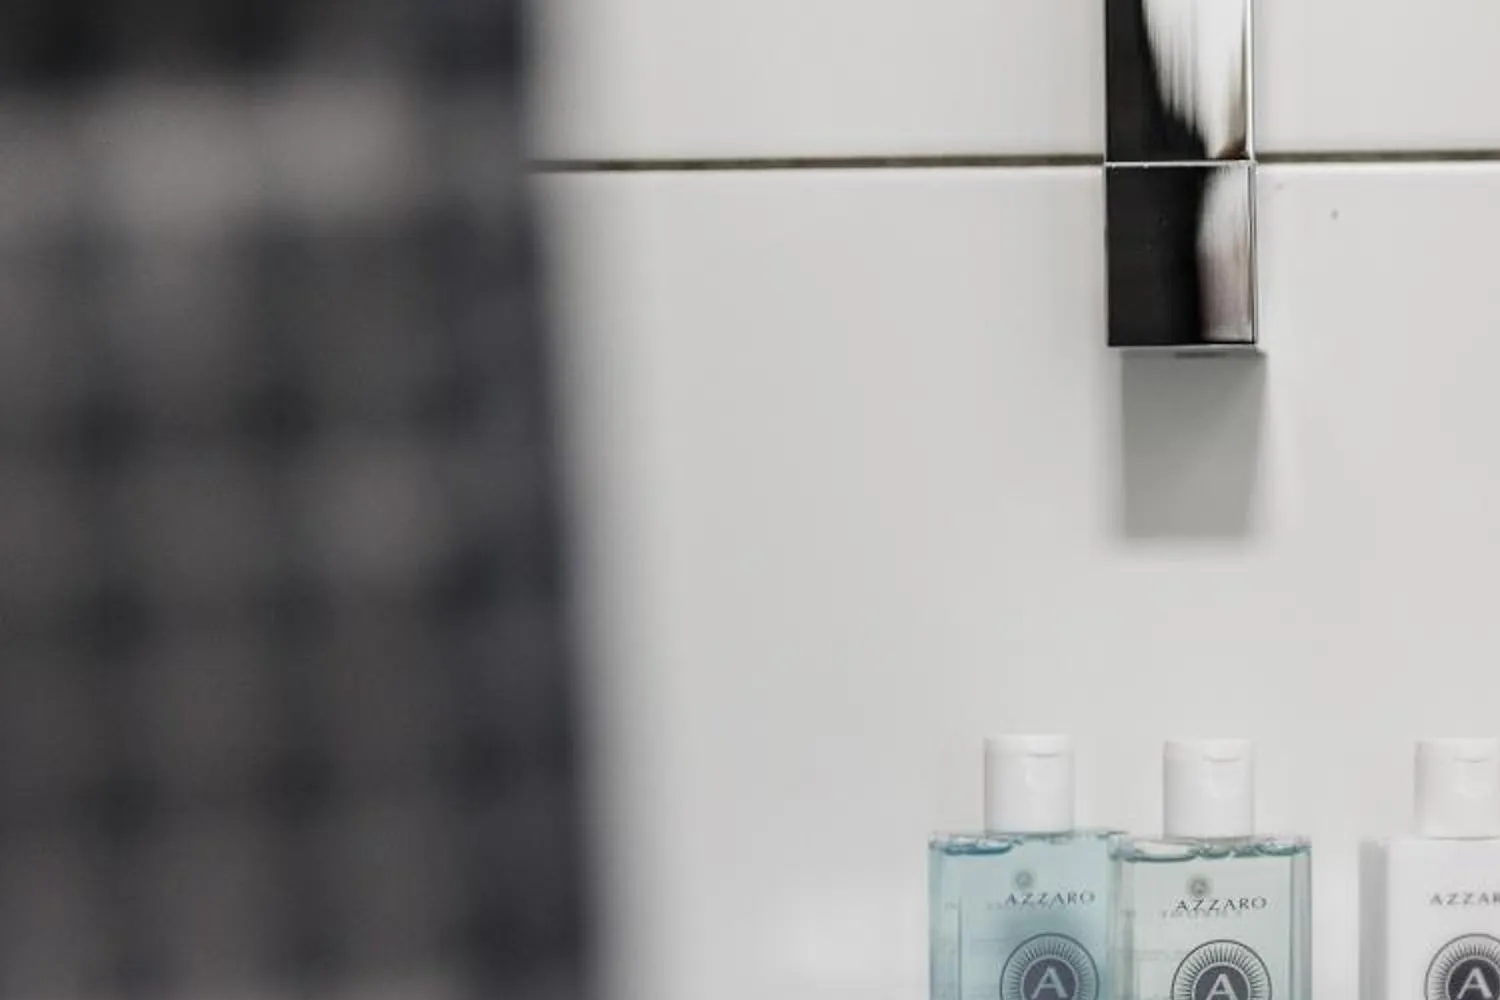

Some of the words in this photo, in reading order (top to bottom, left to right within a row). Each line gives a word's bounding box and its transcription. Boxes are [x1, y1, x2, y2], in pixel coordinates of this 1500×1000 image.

[1005, 891, 1096, 906] AZZARO
[1175, 896, 1267, 911] AZZARO
[1030, 966, 1068, 1000] A
[1455, 967, 1493, 1000] A
